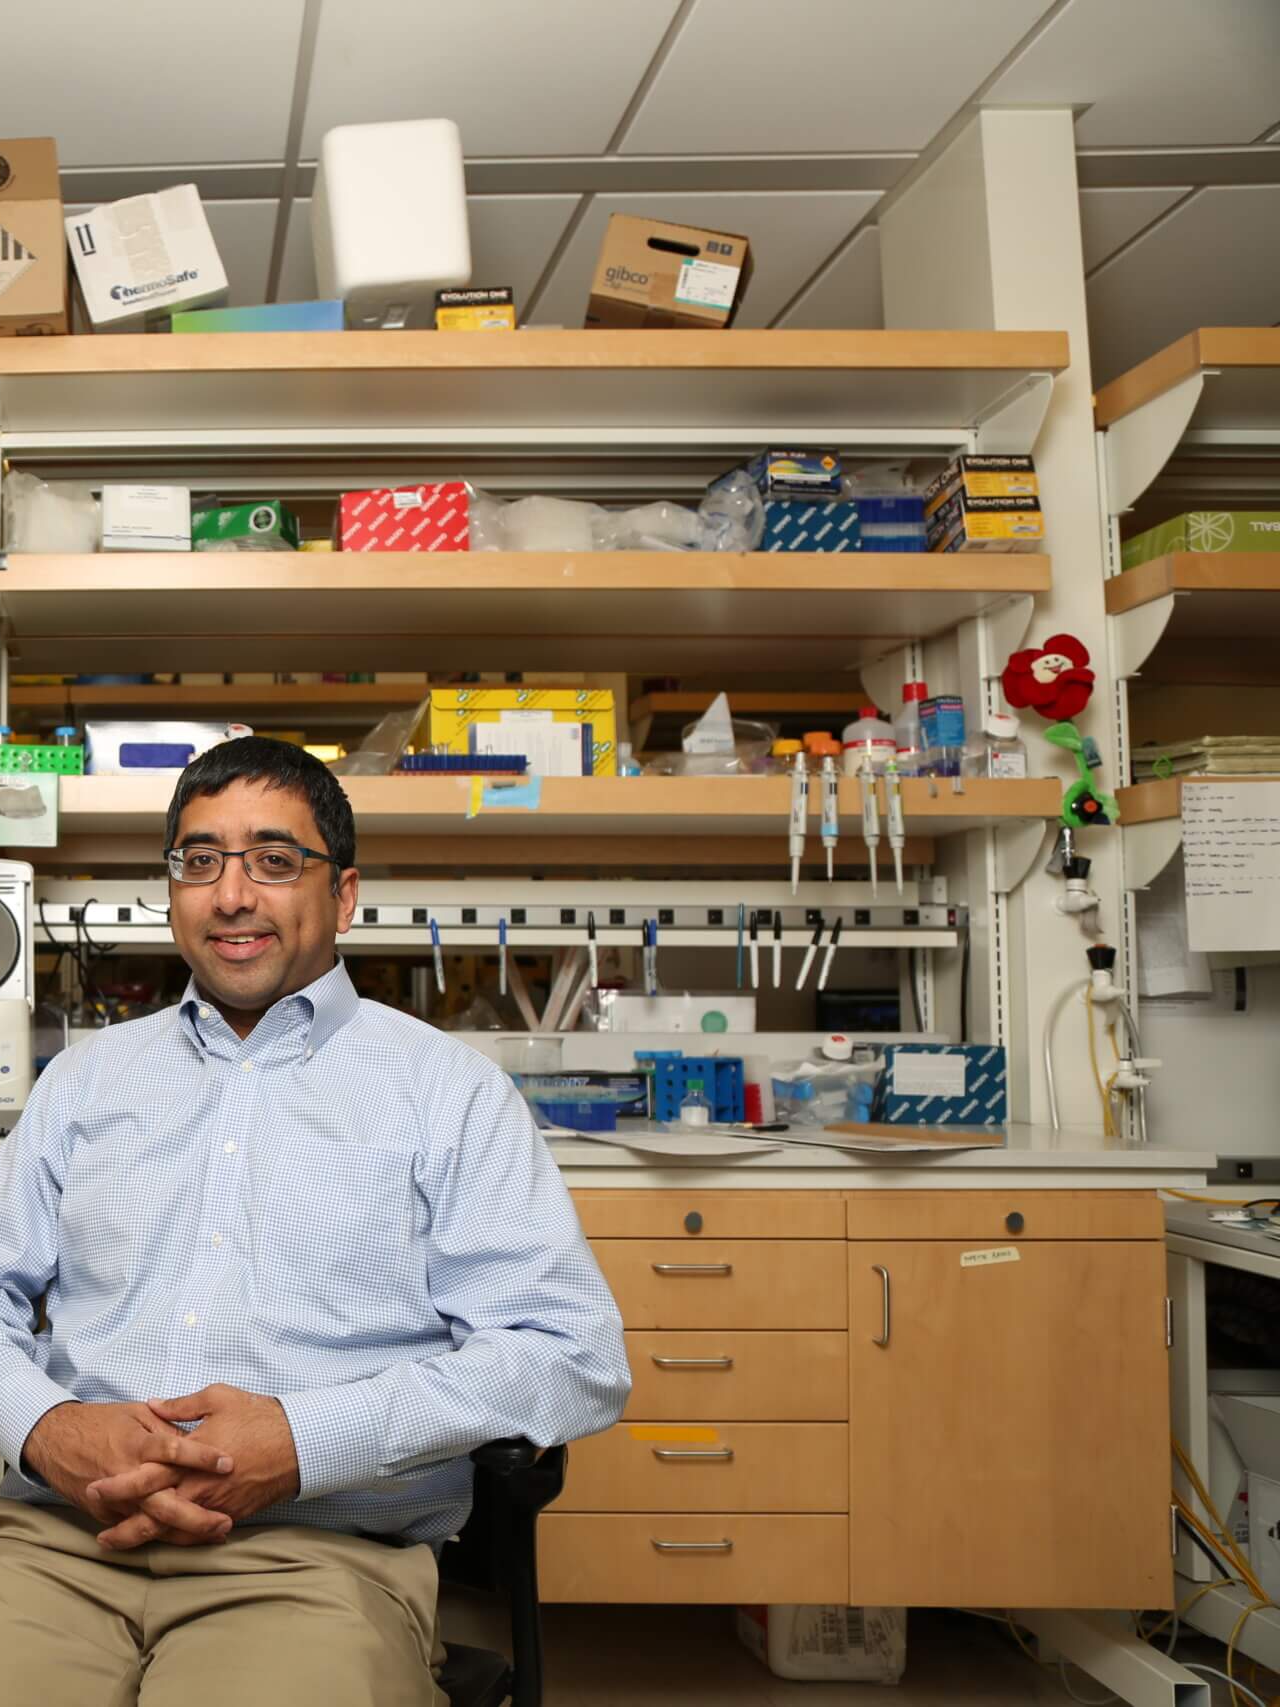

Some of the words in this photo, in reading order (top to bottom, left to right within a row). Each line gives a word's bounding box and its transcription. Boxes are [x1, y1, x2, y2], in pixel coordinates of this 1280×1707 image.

[606, 265, 649, 285] gibco
[110, 269, 199, 300] ThermoSafe
[965, 457, 1010, 466] EVOLUTION
[1012, 458, 1029, 466] ONE
[966, 497, 1015, 506] EVOLUTION
[1016, 498, 1035, 506] ONE
